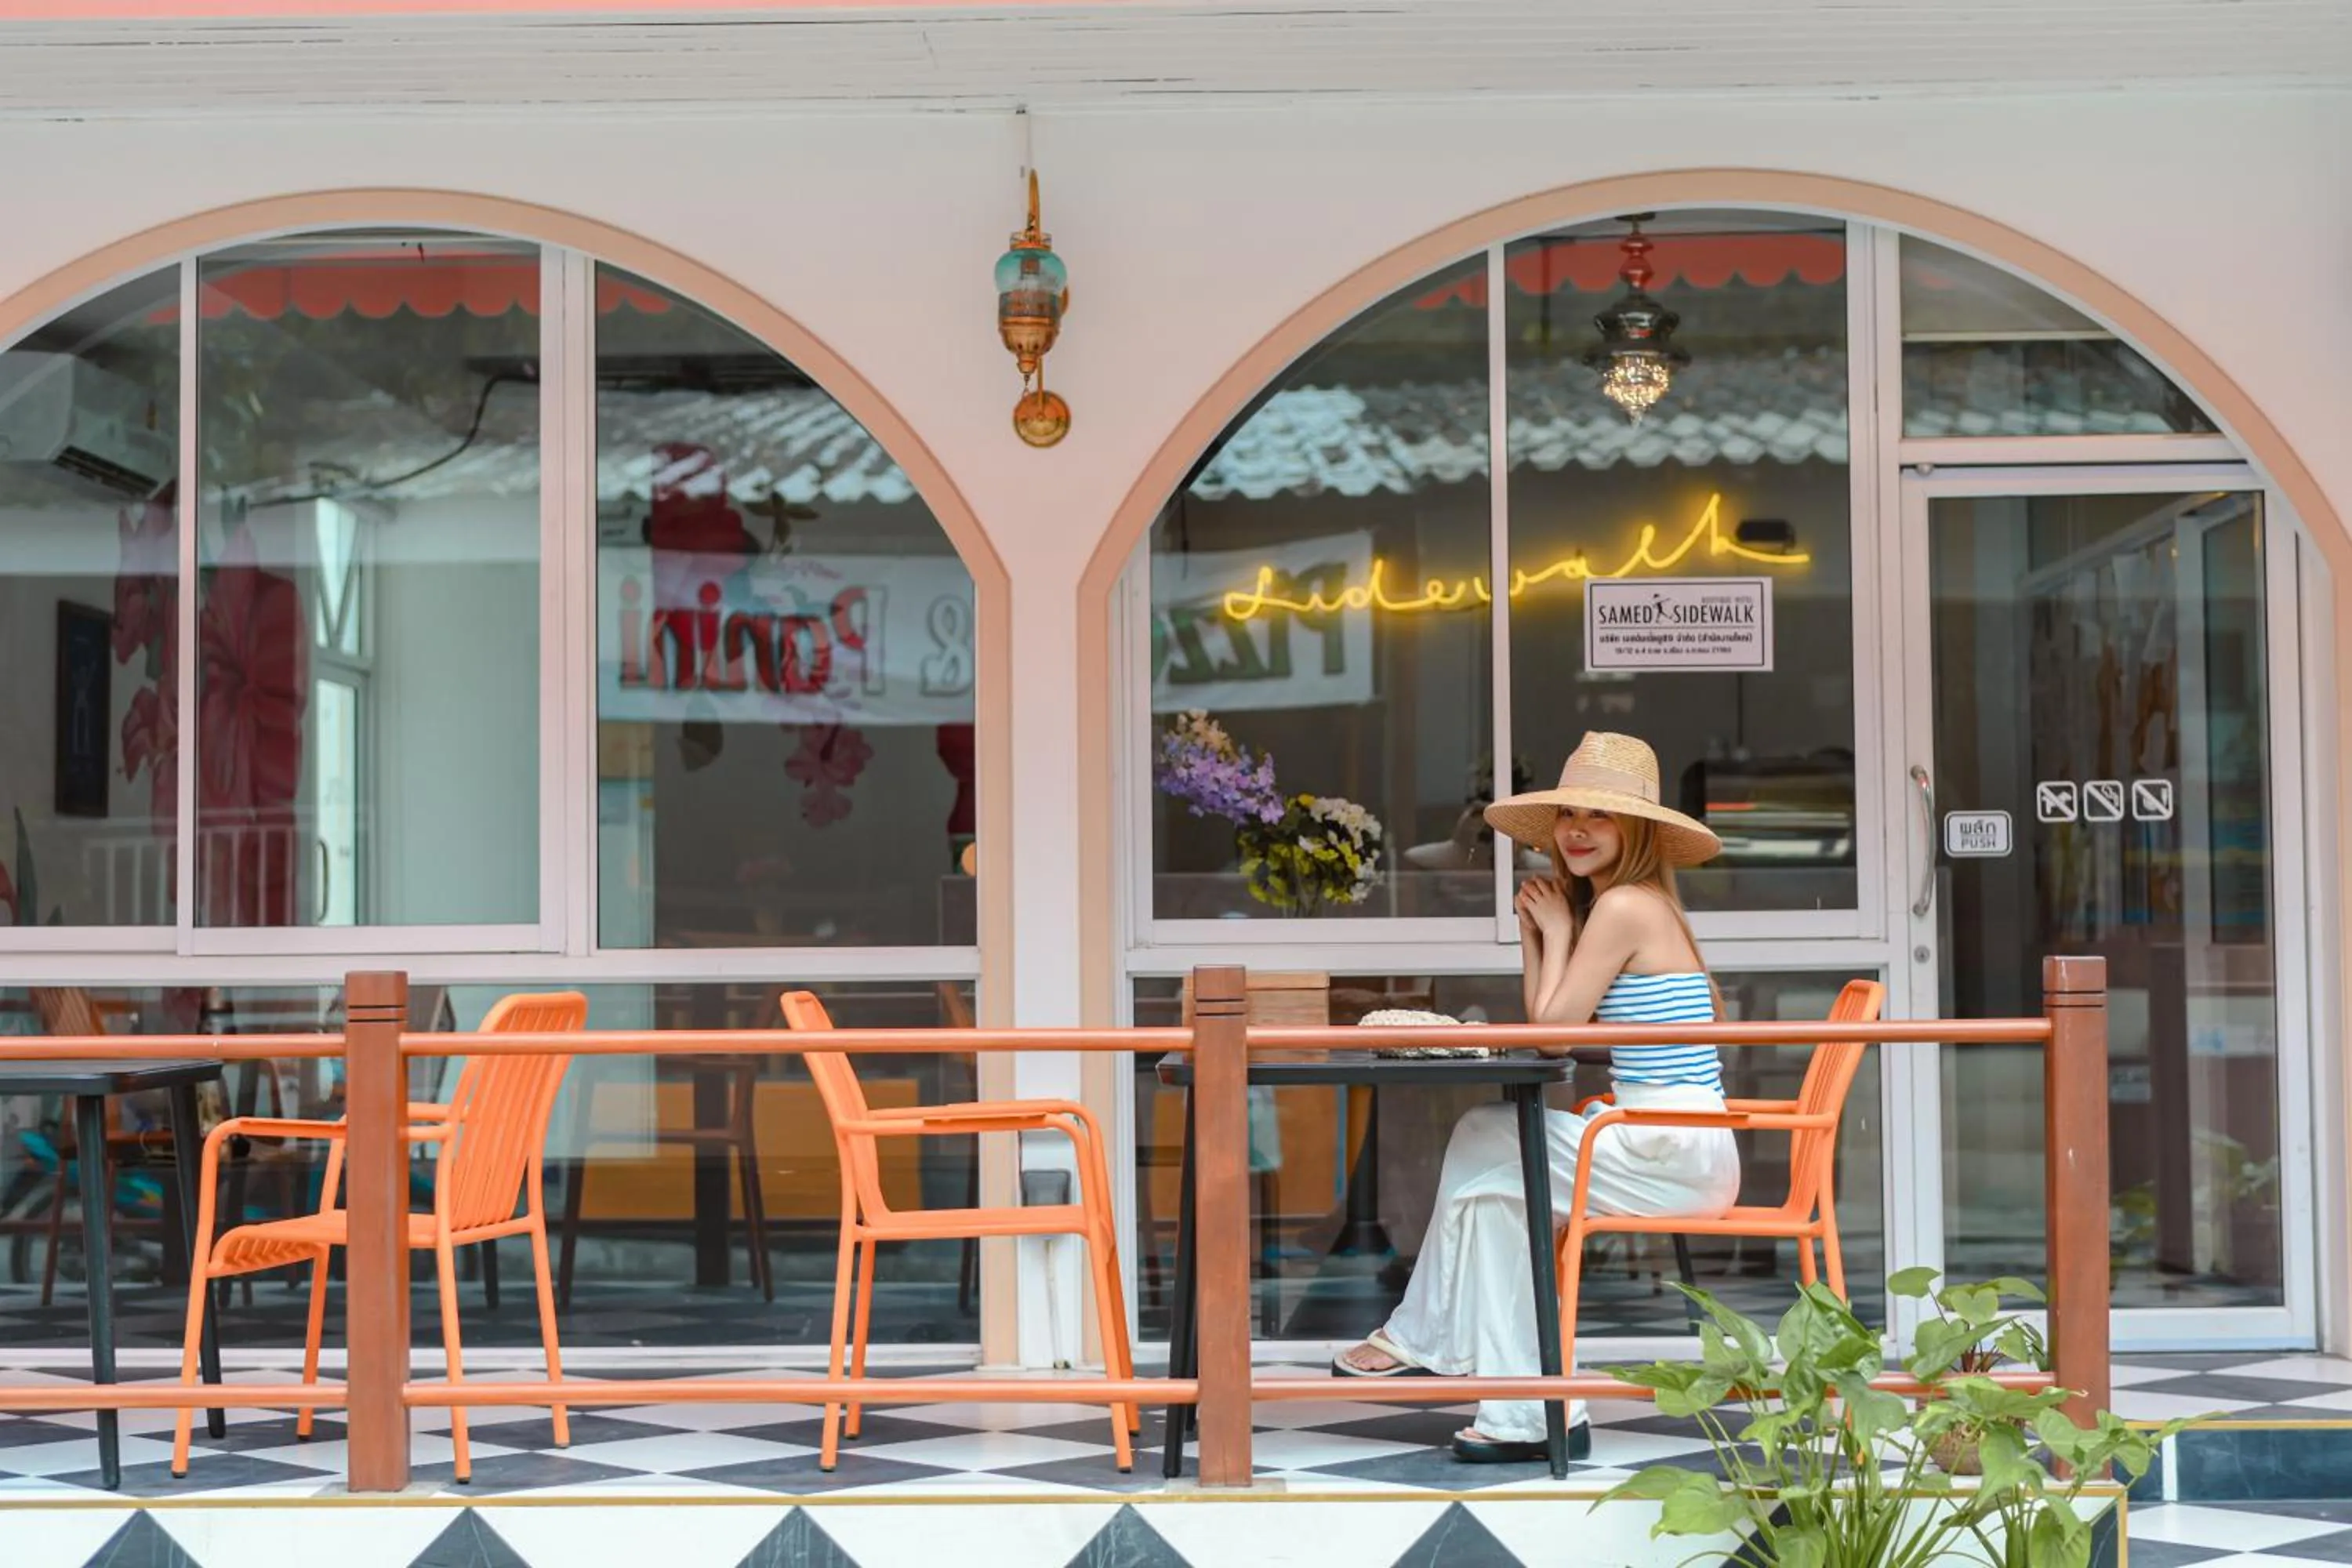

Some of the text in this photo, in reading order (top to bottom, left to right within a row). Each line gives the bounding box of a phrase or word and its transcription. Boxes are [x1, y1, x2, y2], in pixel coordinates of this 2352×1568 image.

[1599, 604, 1755, 624] SAMED SIDEWALK
[1962, 838, 1996, 849] PUSH
